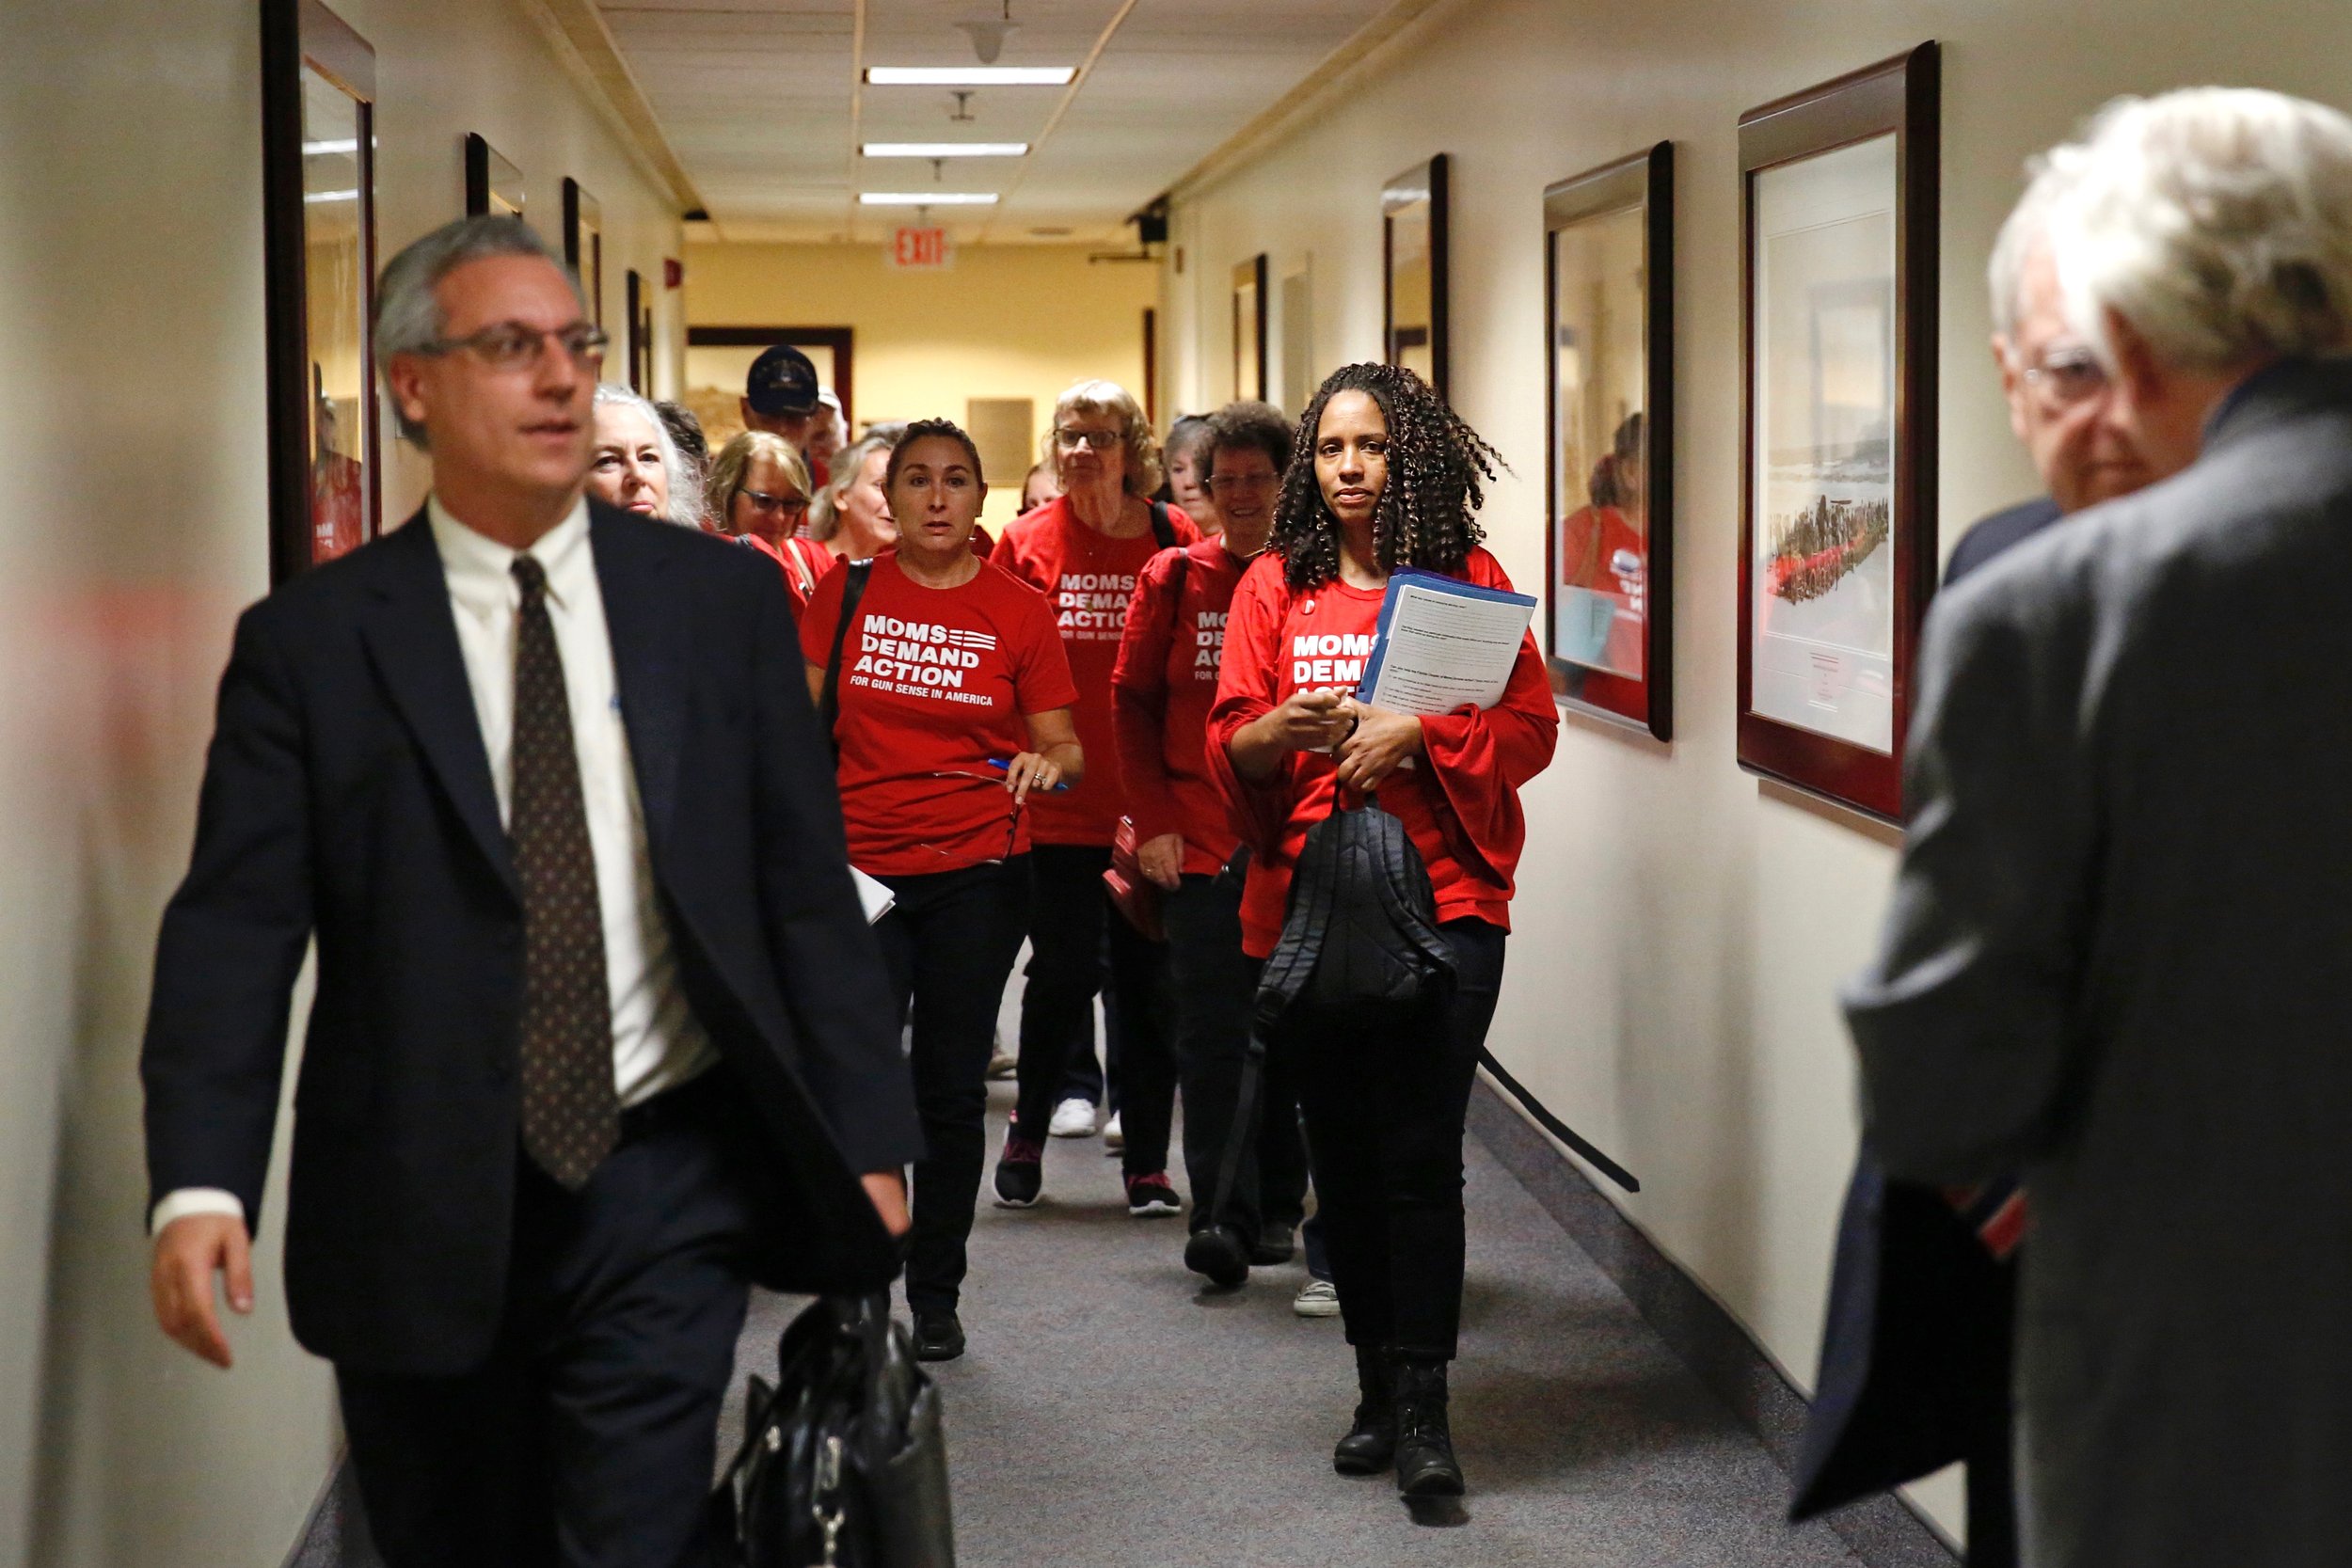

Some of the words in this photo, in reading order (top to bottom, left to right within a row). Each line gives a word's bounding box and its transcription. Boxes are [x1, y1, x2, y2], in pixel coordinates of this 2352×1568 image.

[895, 227, 945, 265] EXIT
[1060, 574, 1136, 591] MOMS
[1059, 593, 1135, 610] DEMA
[864, 614, 948, 644] MOMS
[861, 633, 979, 669] DEMAND
[853, 655, 963, 688] ACTION
[1195, 671, 1213, 680] FOR
[1294, 658, 1369, 684] DEM
[850, 675, 869, 687] FOR
[871, 679, 894, 691] GUN
[896, 683, 930, 698] SENSE
[930, 689, 943, 700] IN
[945, 691, 993, 706] AMERICA
